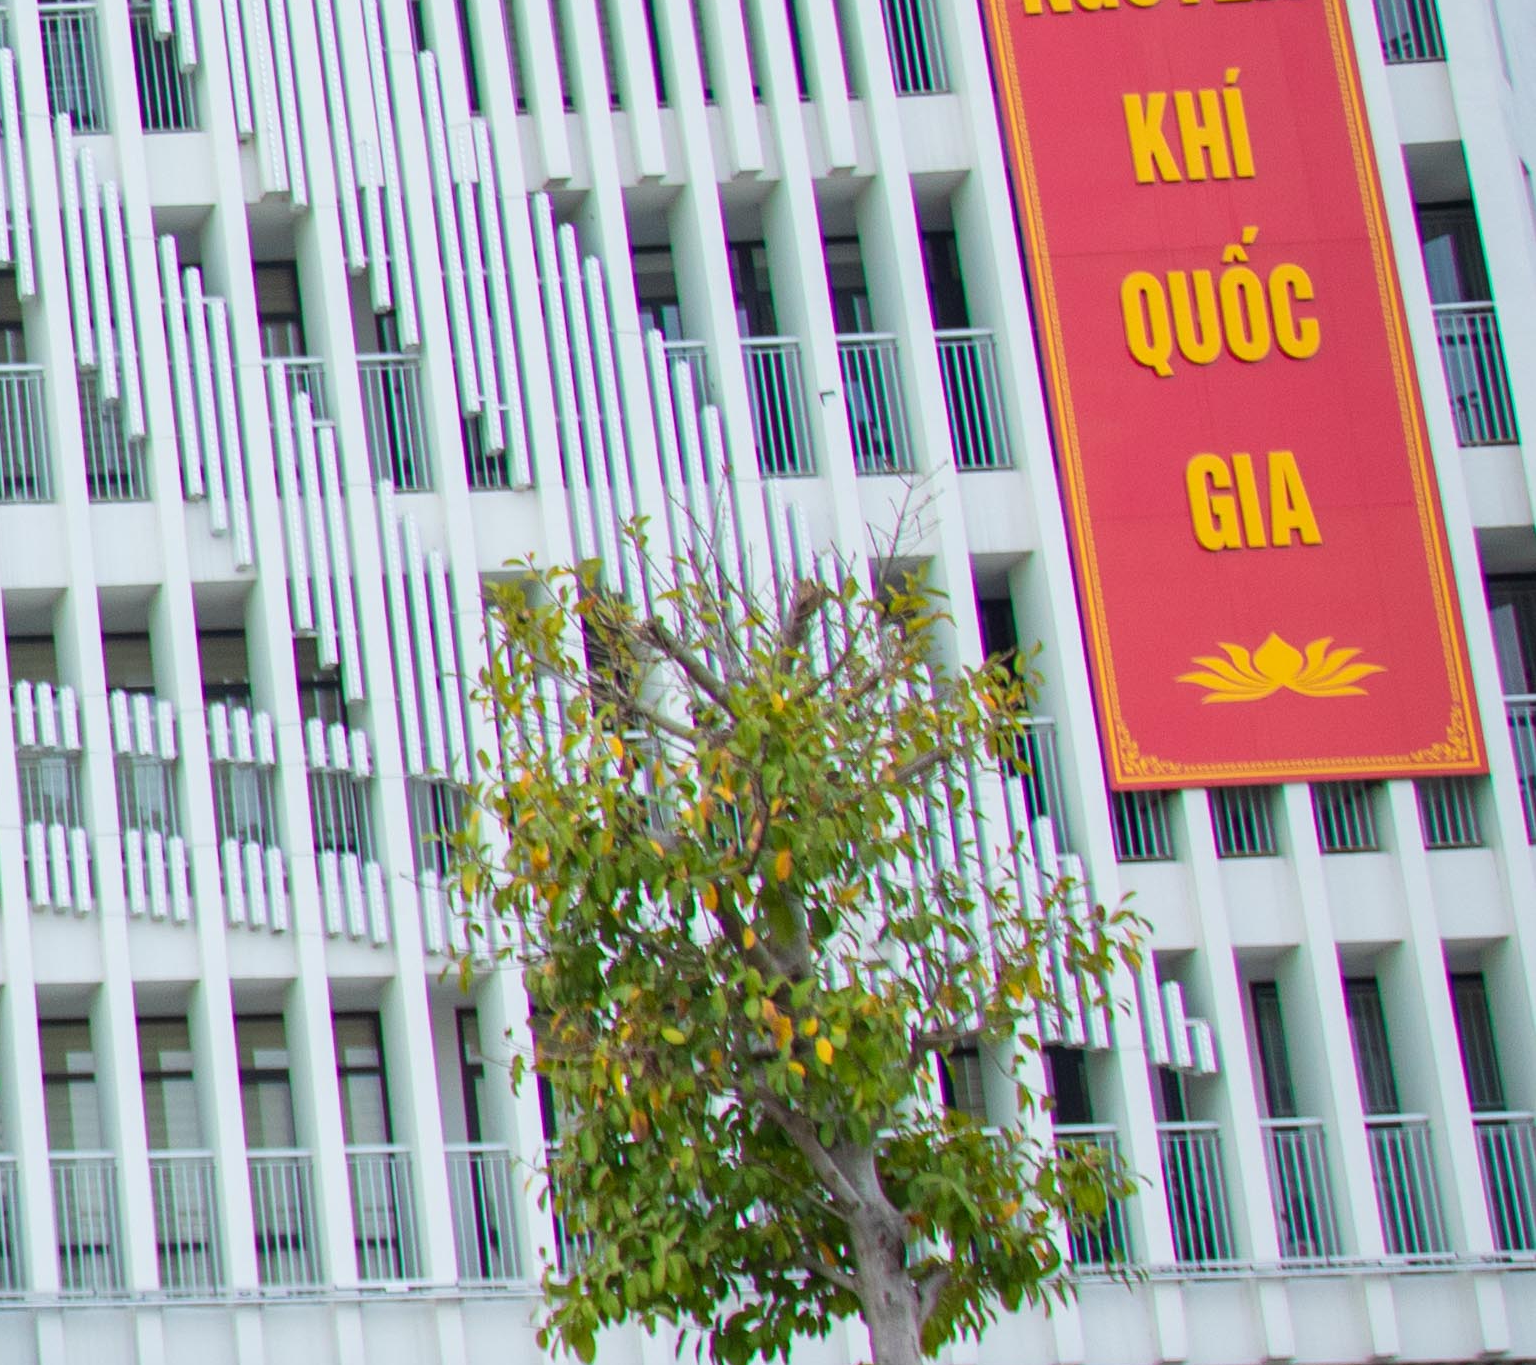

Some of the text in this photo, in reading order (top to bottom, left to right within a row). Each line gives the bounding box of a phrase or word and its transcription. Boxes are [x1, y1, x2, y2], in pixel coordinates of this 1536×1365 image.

[1122, 66, 1257, 186] KHÍ
[1119, 225, 1322, 379] QUỐC
[1184, 448, 1324, 553] GIA
